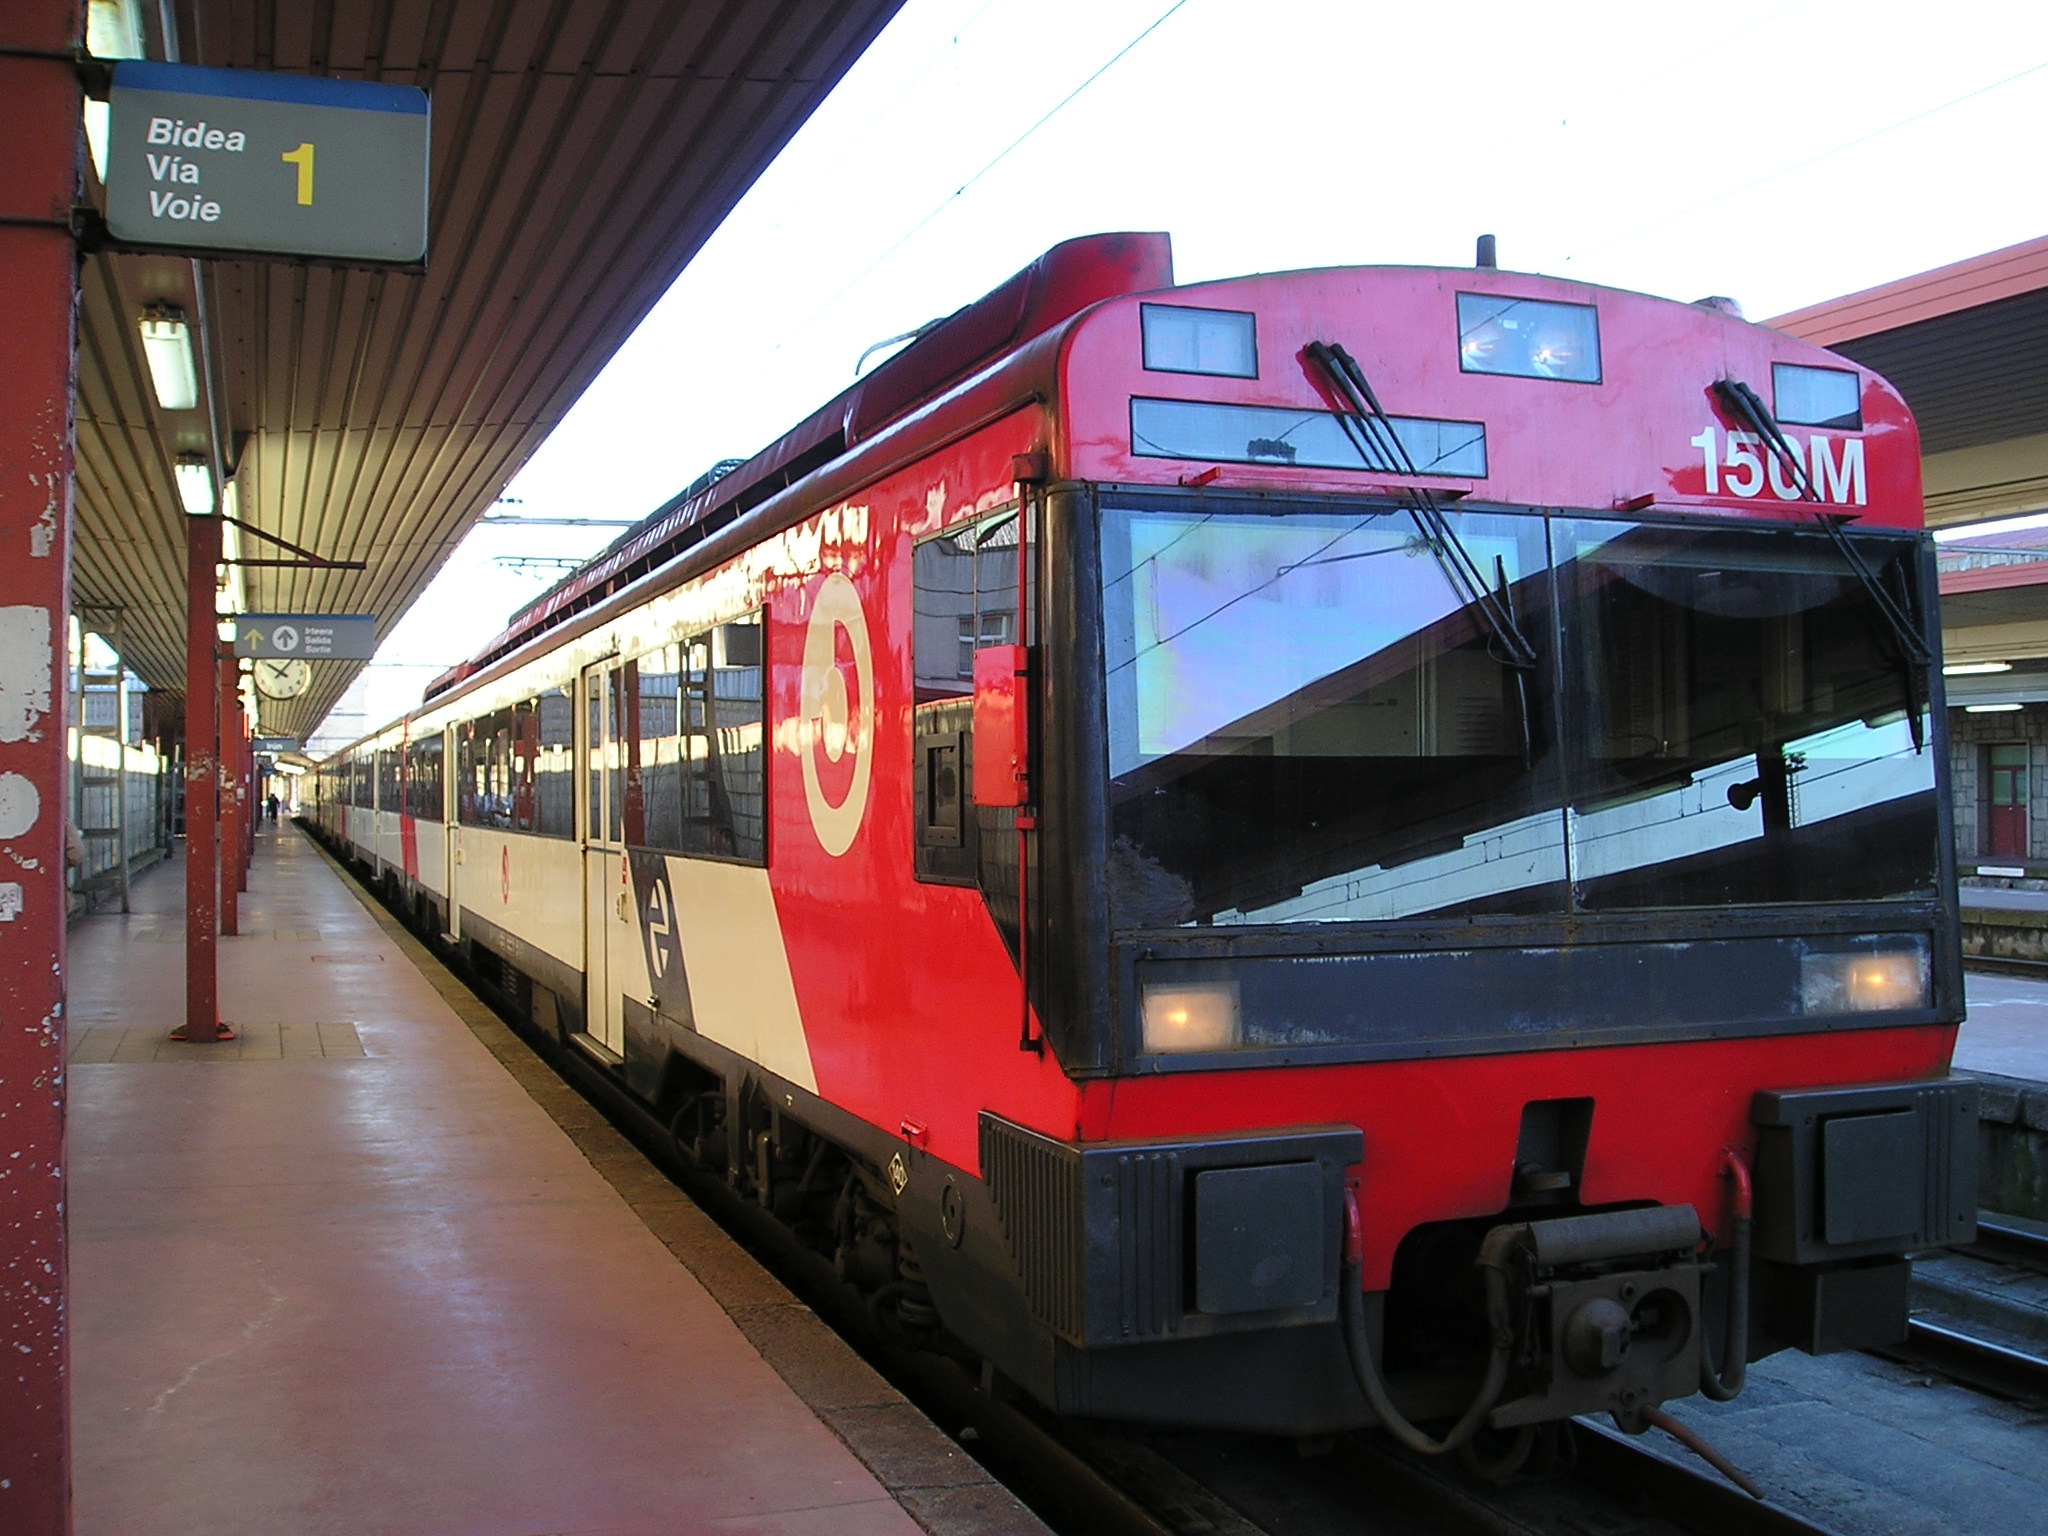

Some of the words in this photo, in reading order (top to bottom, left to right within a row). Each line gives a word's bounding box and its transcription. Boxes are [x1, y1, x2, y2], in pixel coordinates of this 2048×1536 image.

[147, 117, 246, 152] Bidea
[146, 153, 199, 185] Vía
[281, 143, 314, 205] 1
[150, 190, 221, 222] Voie
[1690, 426, 1867, 506] 150M
[304, 636, 331, 644] Salida
[304, 645, 332, 654] Sortie
